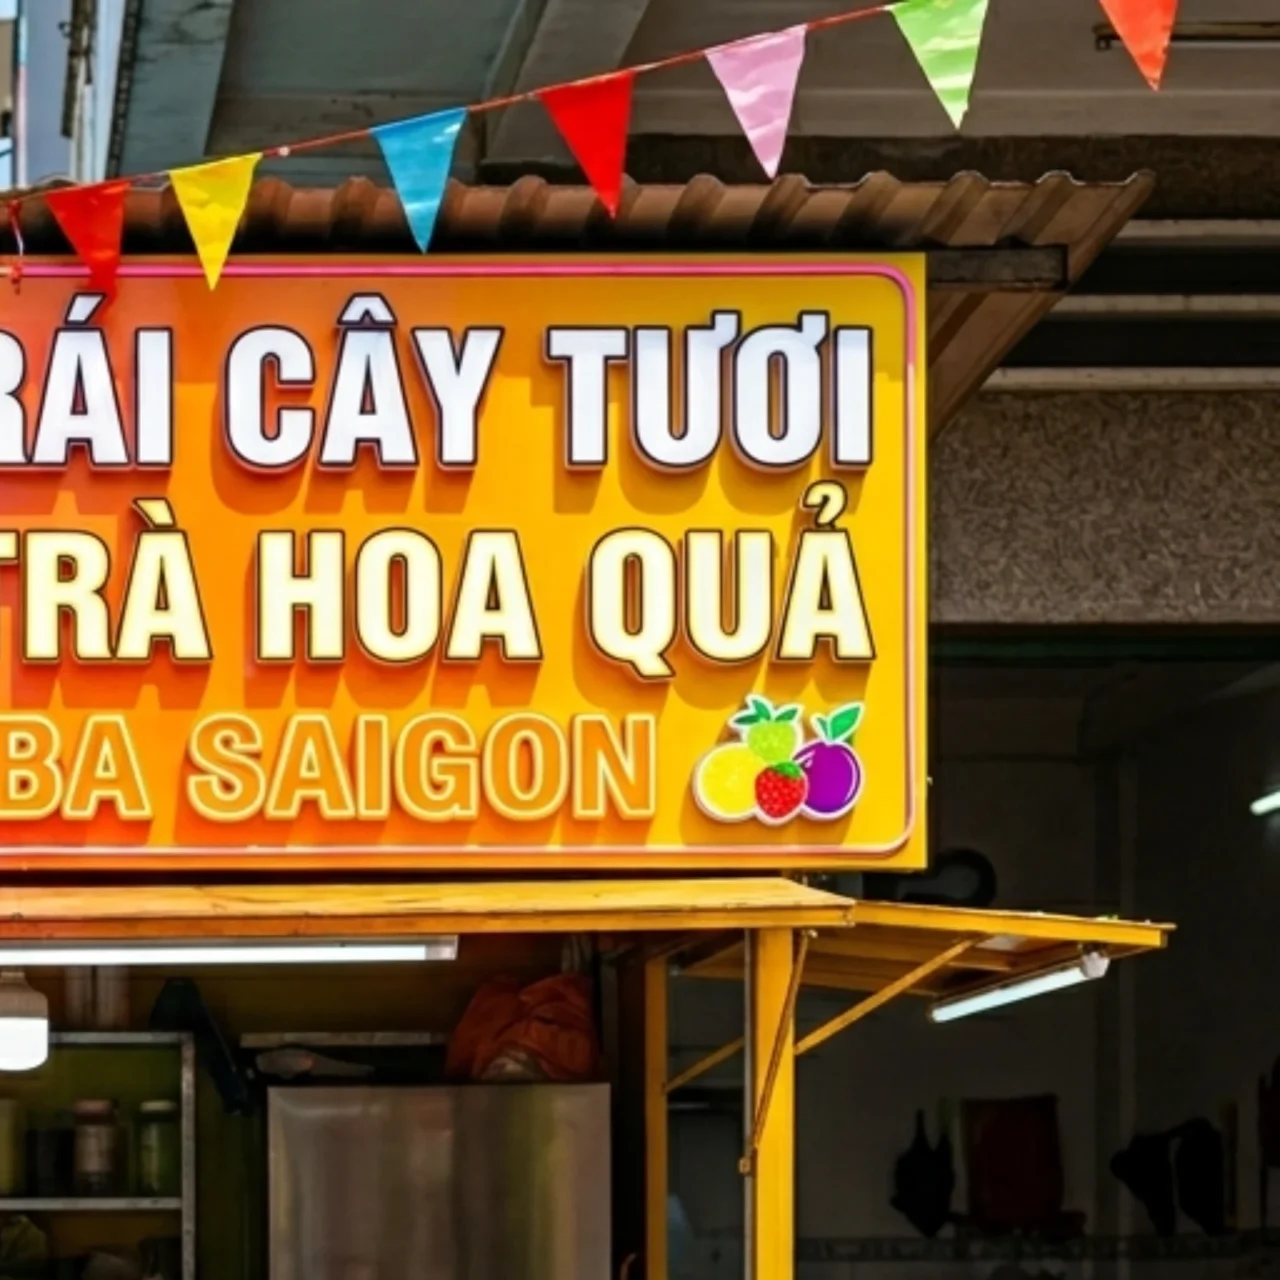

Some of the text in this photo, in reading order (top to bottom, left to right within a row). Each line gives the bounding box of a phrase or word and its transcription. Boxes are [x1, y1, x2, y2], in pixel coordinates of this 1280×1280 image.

[224, 293, 505, 469] CÂY
[546, 310, 875, 469] TƯƠI
[256, 527, 543, 663] HOA
[588, 481, 876, 680] QUẢ
[187, 713, 658, 821] SAIGON
